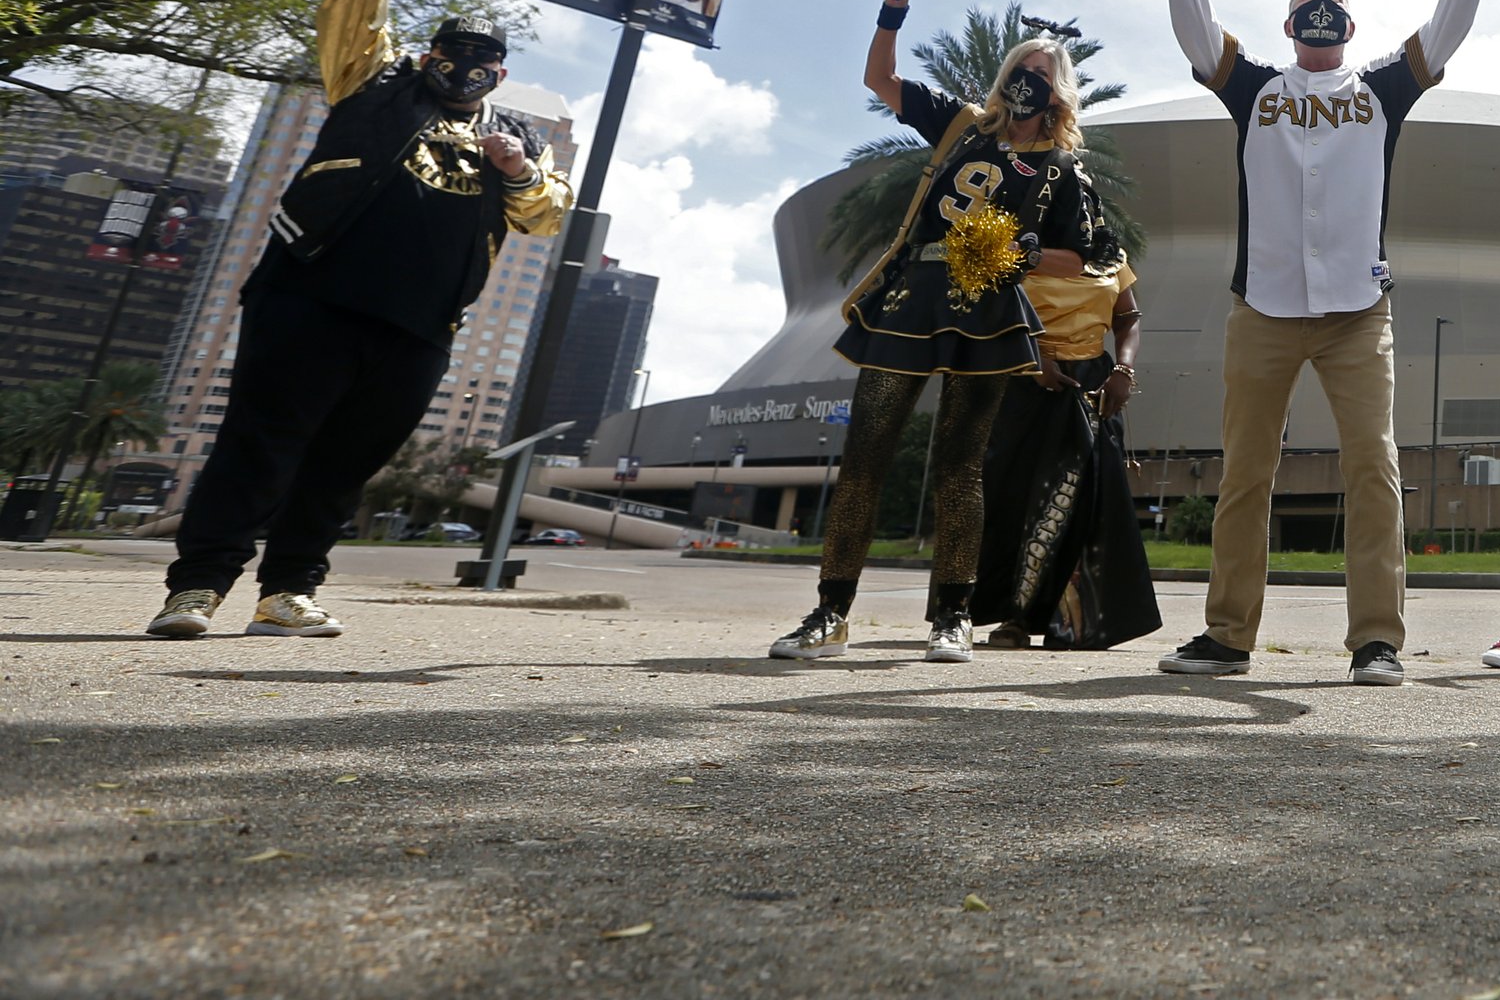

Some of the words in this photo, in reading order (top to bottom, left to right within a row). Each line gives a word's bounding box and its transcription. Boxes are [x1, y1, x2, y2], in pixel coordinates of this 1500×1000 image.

[1258, 91, 1375, 130] SAINTS
[938, 161, 1004, 224] 9
[1036, 165, 1062, 223] DAT
[706, 399, 797, 427] Mercedes-Benz
